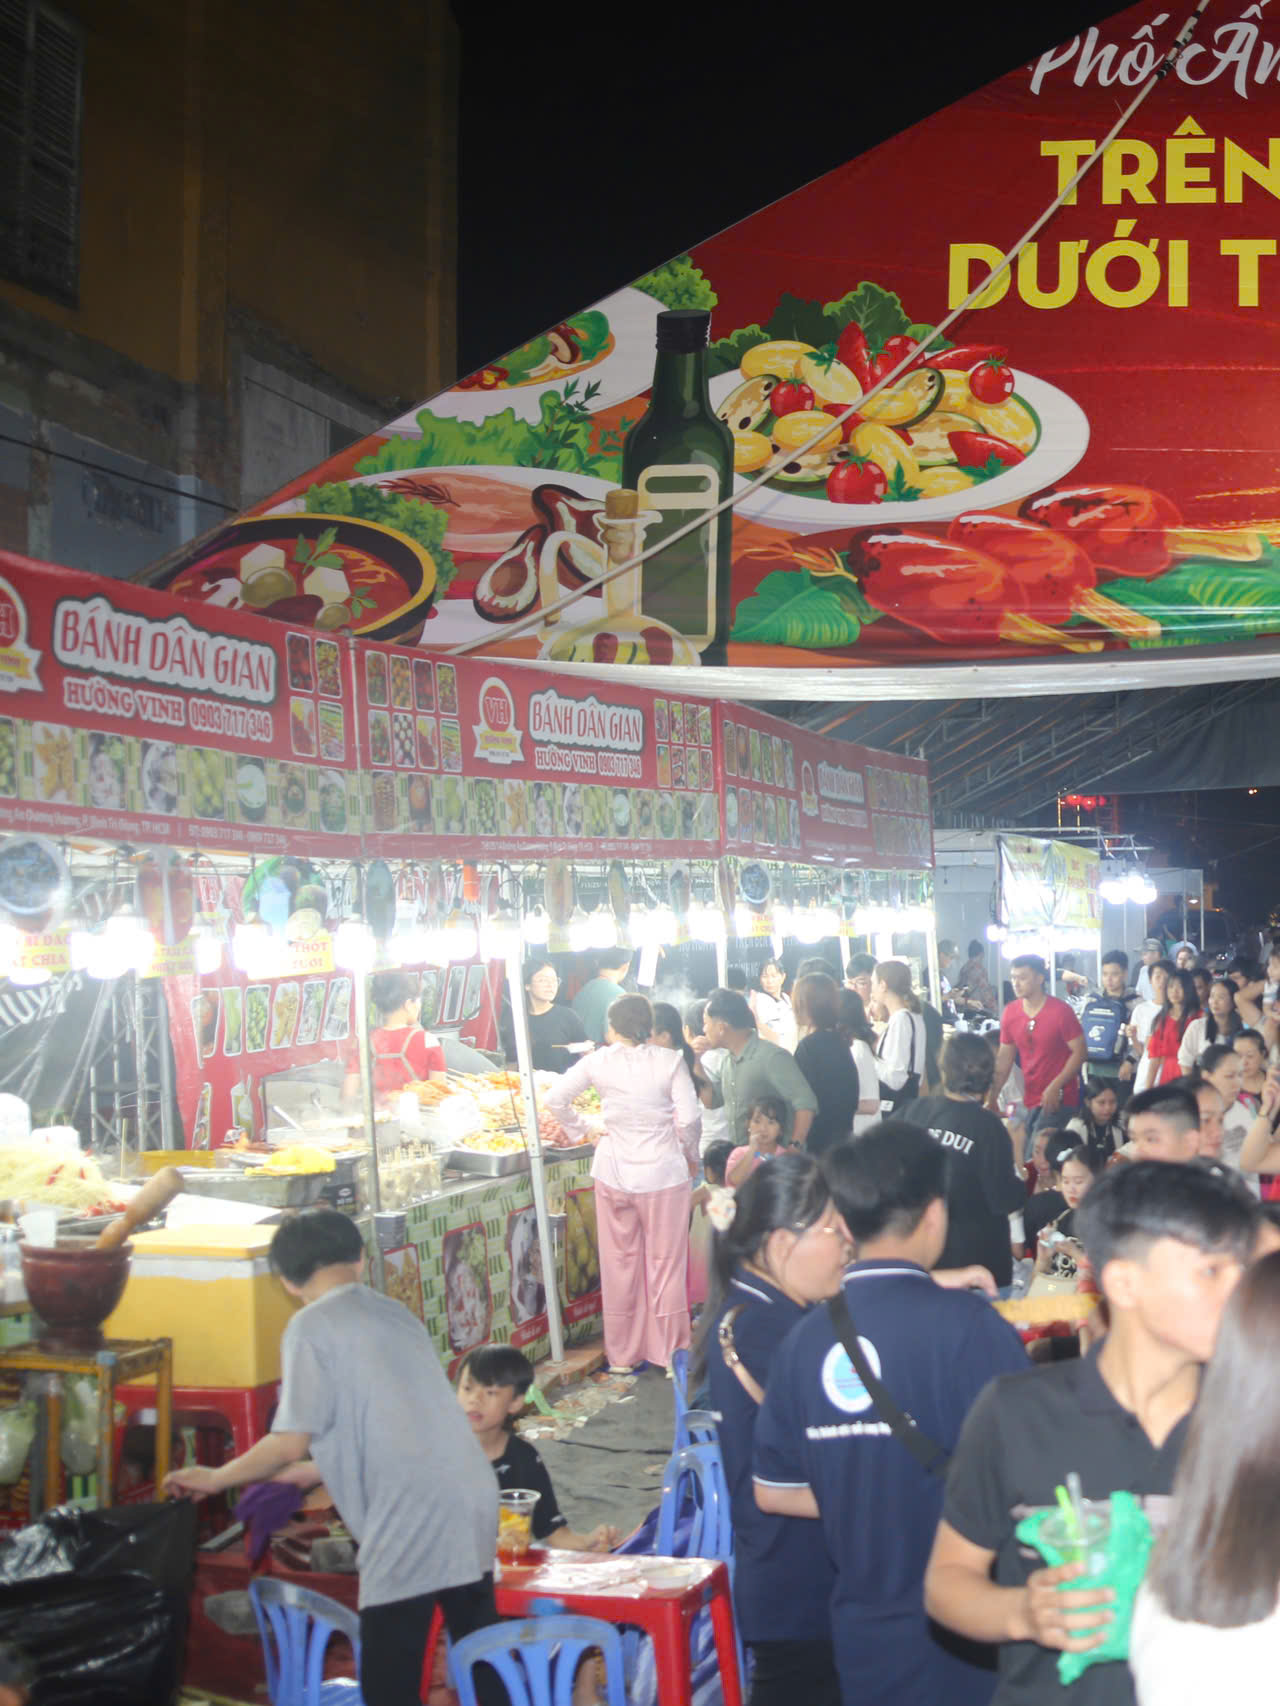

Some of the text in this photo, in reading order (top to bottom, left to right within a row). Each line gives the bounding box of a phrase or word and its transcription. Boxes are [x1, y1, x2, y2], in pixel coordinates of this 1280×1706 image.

[1028, 12, 1169, 96] Phố
[948, 218, 1189, 311] DƯỚI
[61, 606, 271, 693] BÁNH DÂN GIAN
[137, 693, 184, 723] VINH
[191, 703, 221, 731] 0903
[224, 709, 247, 736] 717
[248, 713, 271, 740] 346
[485, 696, 509, 725] VH
[532, 695, 641, 743] BÁNH DÂN GIAN
